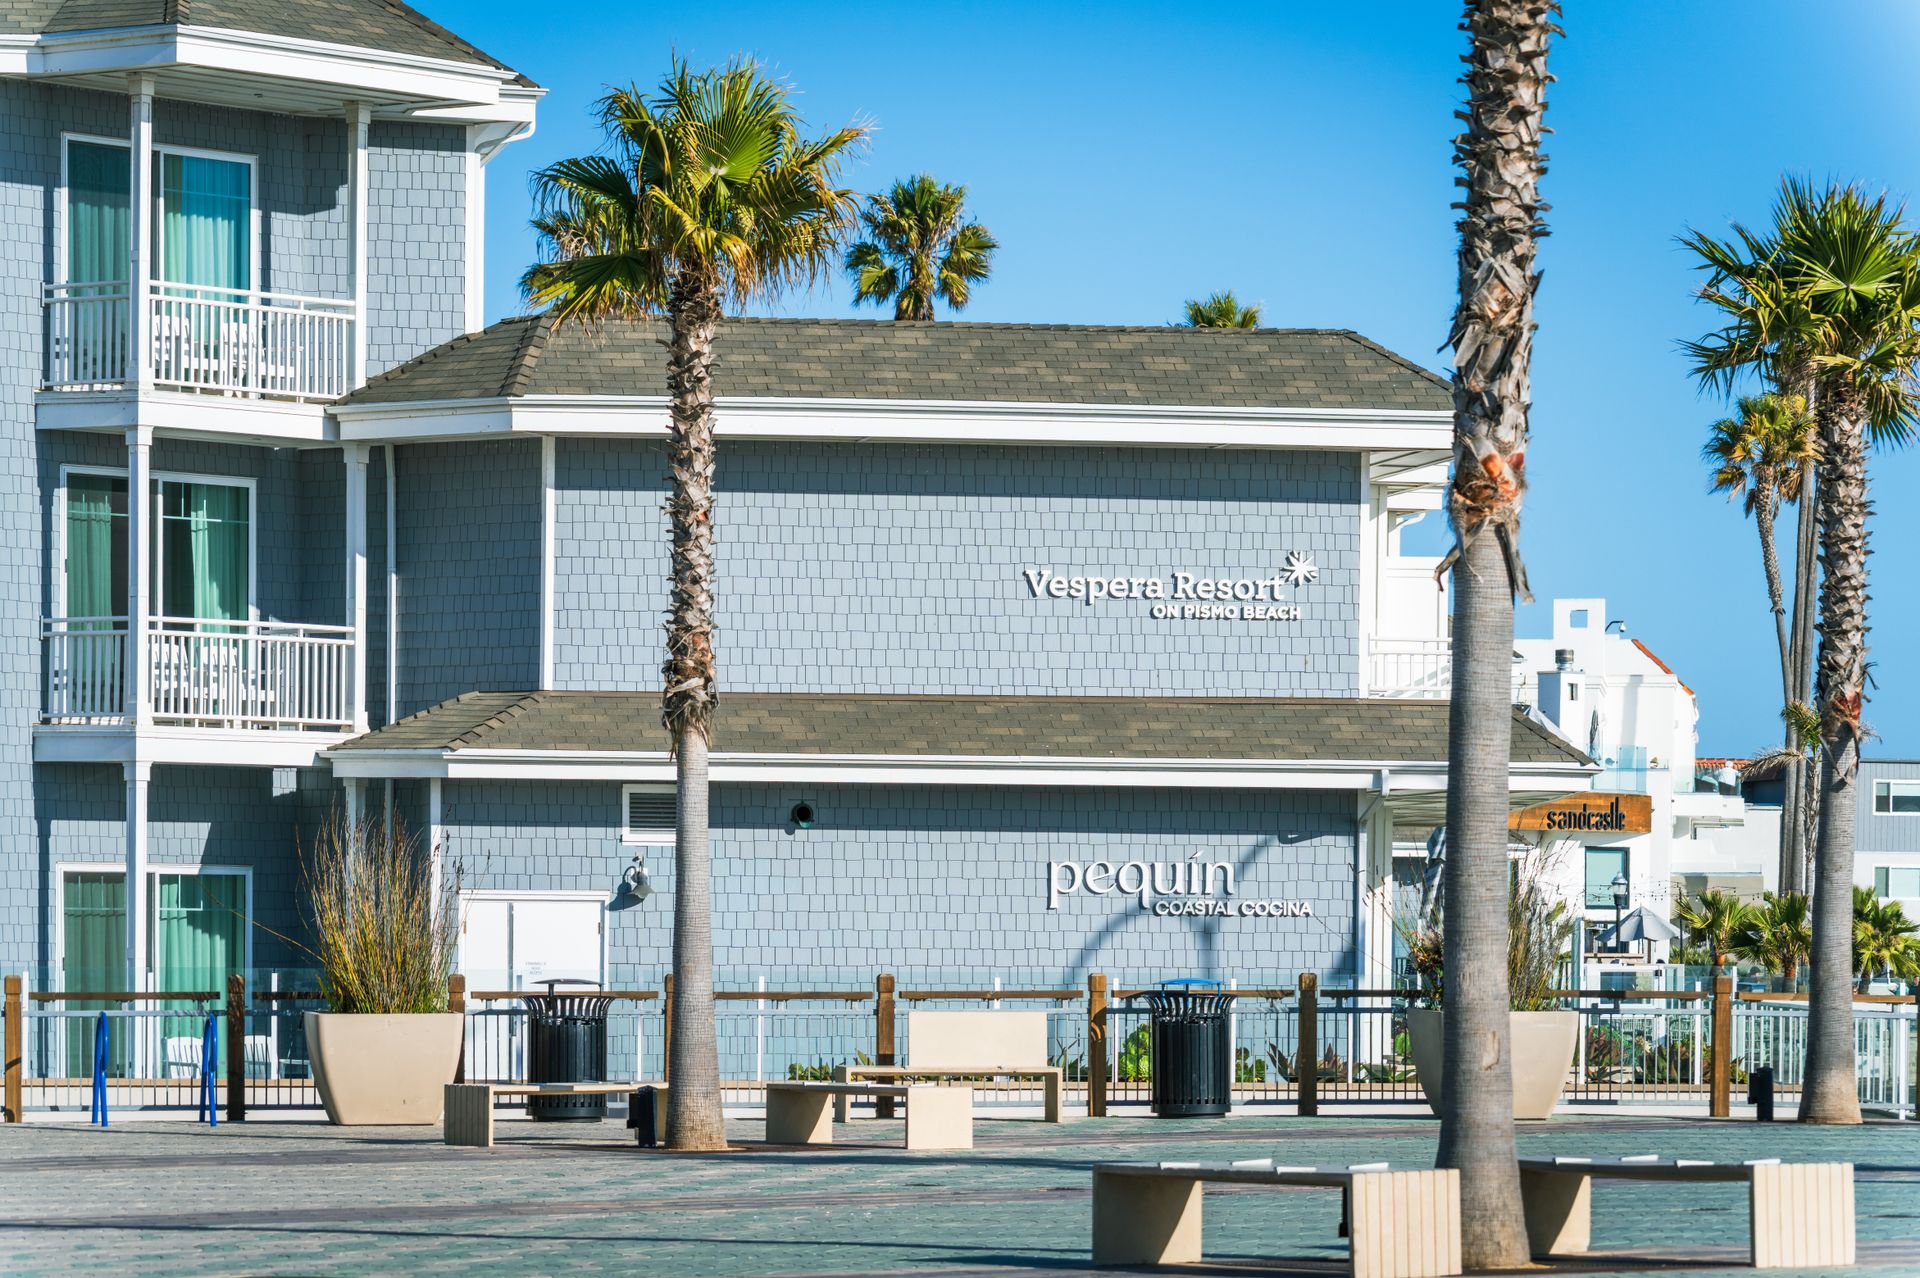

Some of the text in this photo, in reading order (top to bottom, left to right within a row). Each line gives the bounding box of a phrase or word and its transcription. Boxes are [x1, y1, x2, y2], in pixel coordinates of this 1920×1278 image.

[1024, 569, 1286, 605] Vespera Resort
[1151, 604, 1302, 621] ON PISMO BEACH
[1546, 796, 1626, 831] sandcastle
[1048, 850, 1235, 910] pequín
[1154, 900, 1313, 917] COASTAL COCINA
